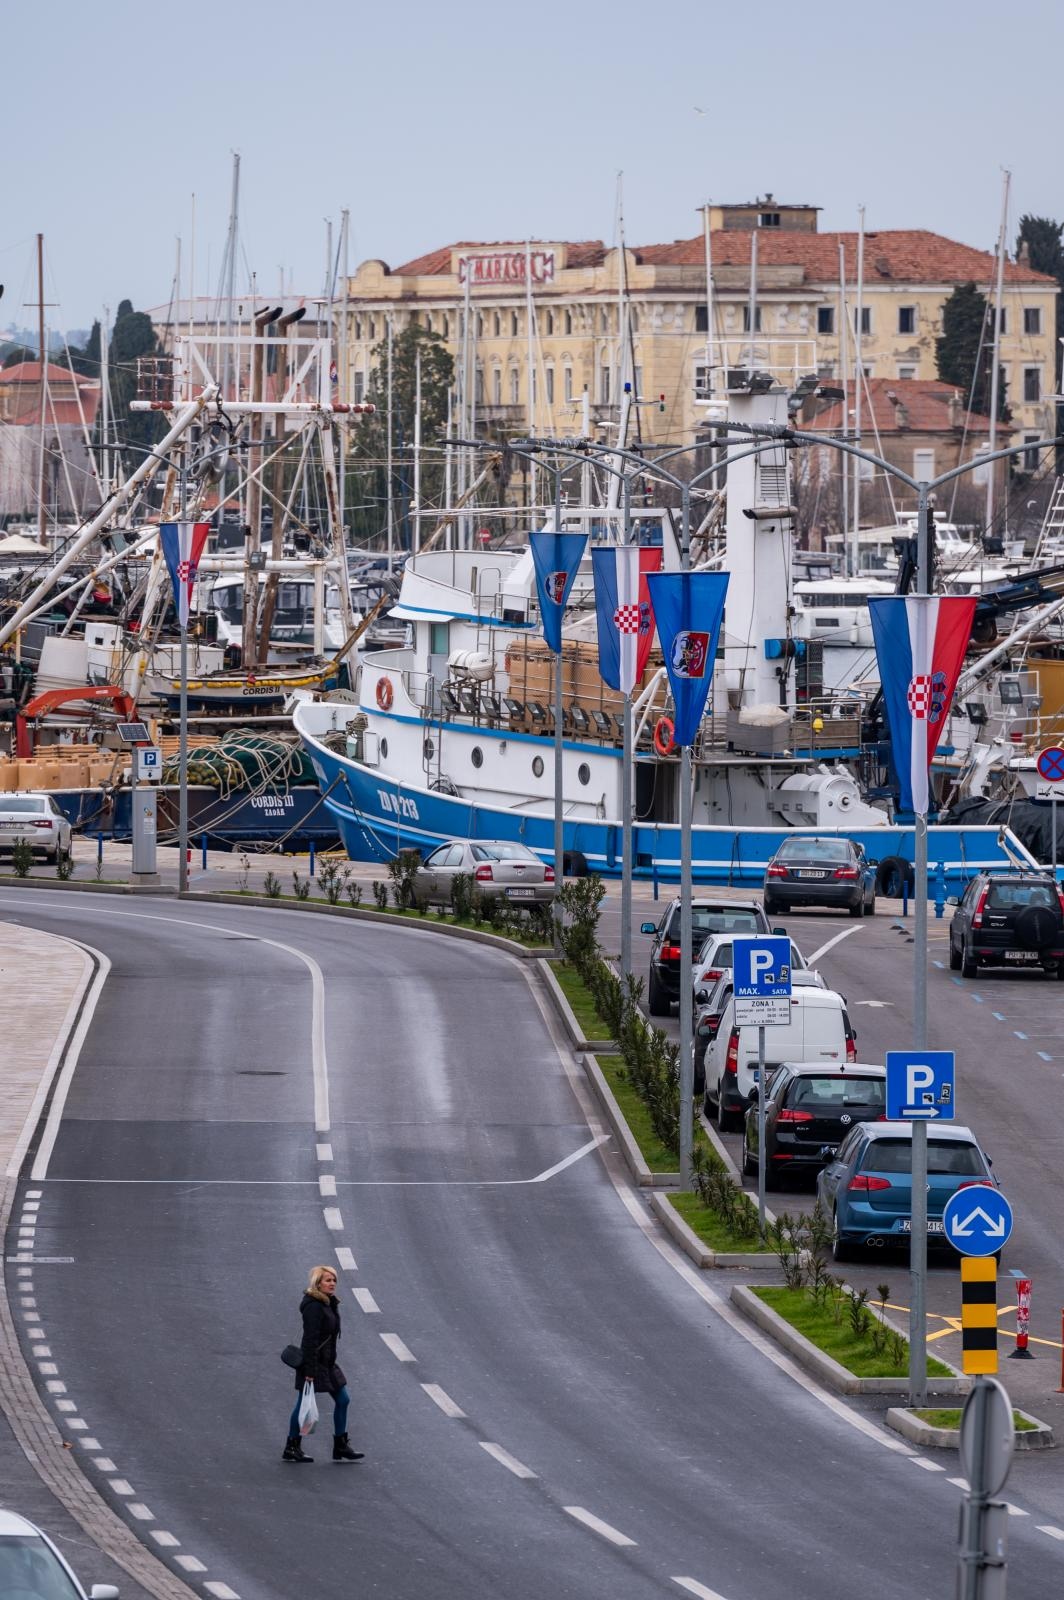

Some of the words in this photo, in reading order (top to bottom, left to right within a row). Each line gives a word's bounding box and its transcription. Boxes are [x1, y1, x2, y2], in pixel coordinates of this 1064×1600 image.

[243, 687, 274, 696] CORDIS
[147, 753, 155, 764] P
[251, 796, 283, 808] CORDIS
[284, 795, 295, 807] III
[750, 950, 774, 984] P
[907, 1065, 935, 1105] P
